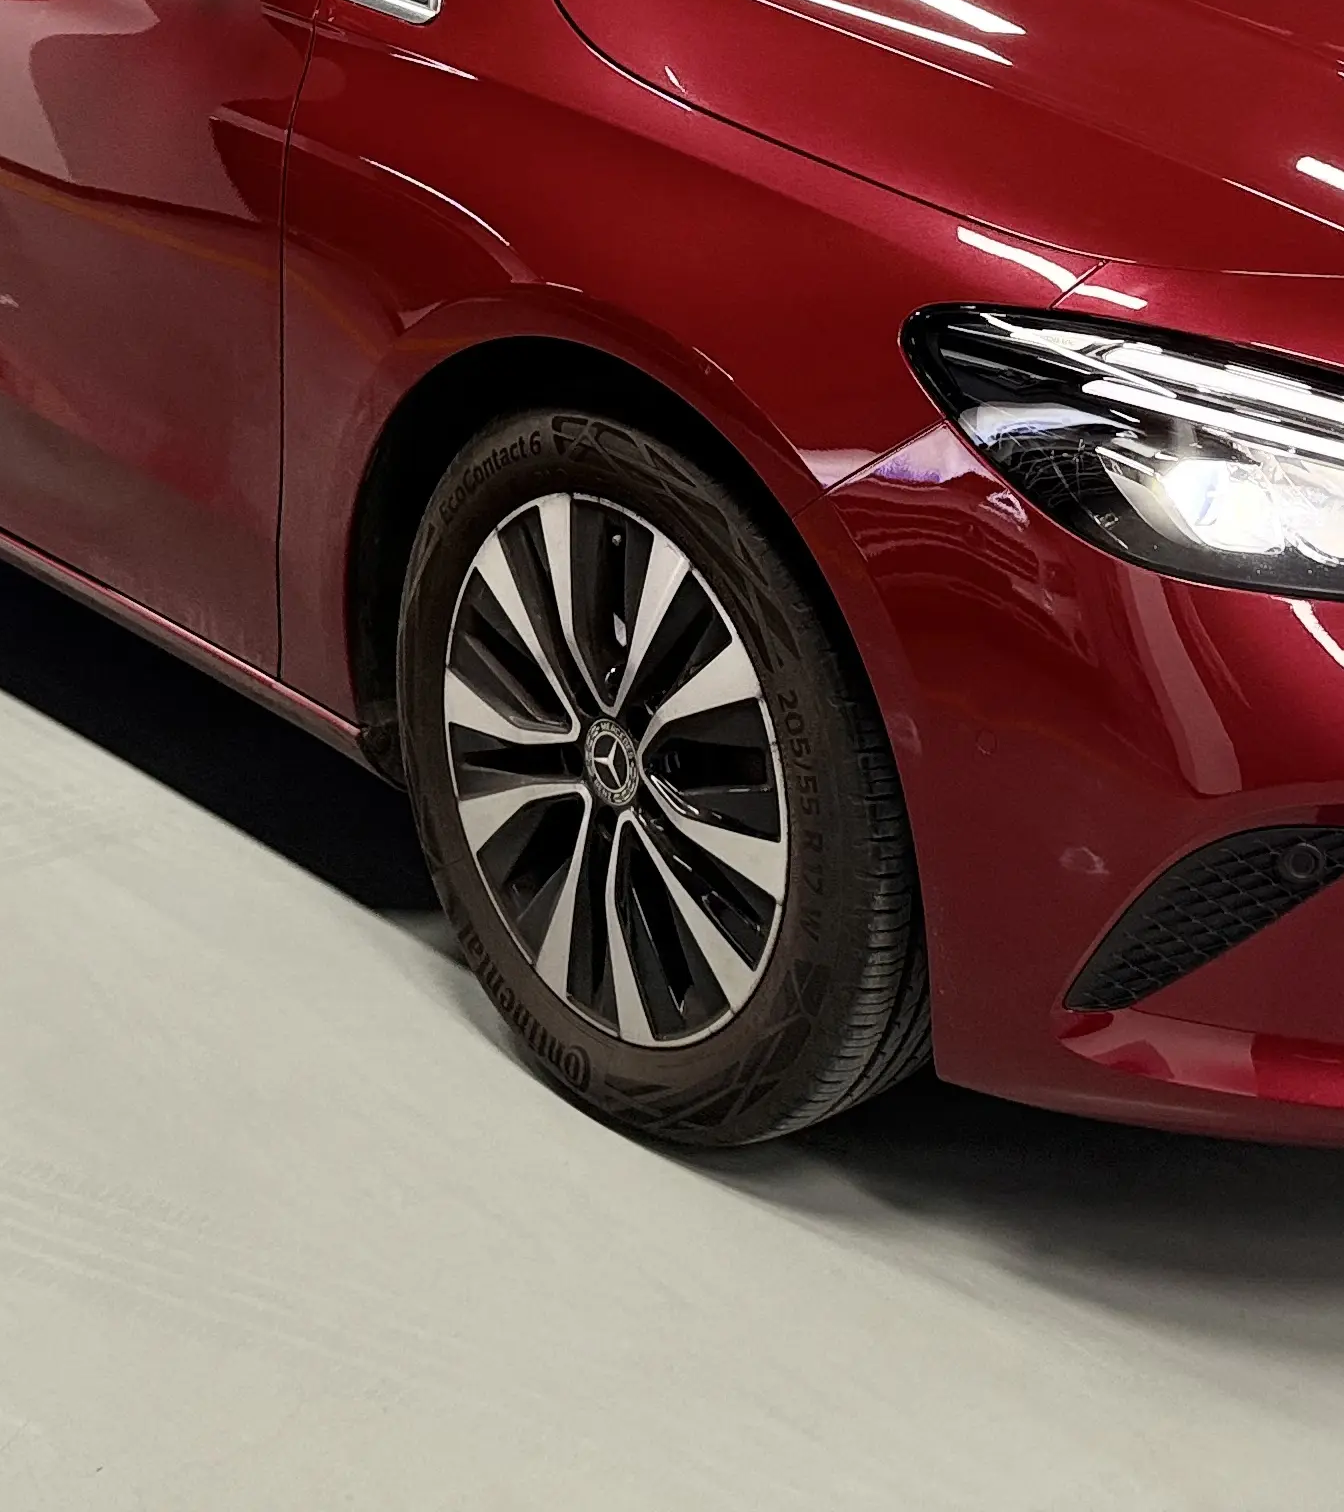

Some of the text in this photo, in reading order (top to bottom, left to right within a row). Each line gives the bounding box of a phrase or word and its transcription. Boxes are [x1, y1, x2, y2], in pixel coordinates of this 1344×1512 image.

[440, 429, 542, 524] EcoContact 6
[777, 689, 821, 816] 205/55
